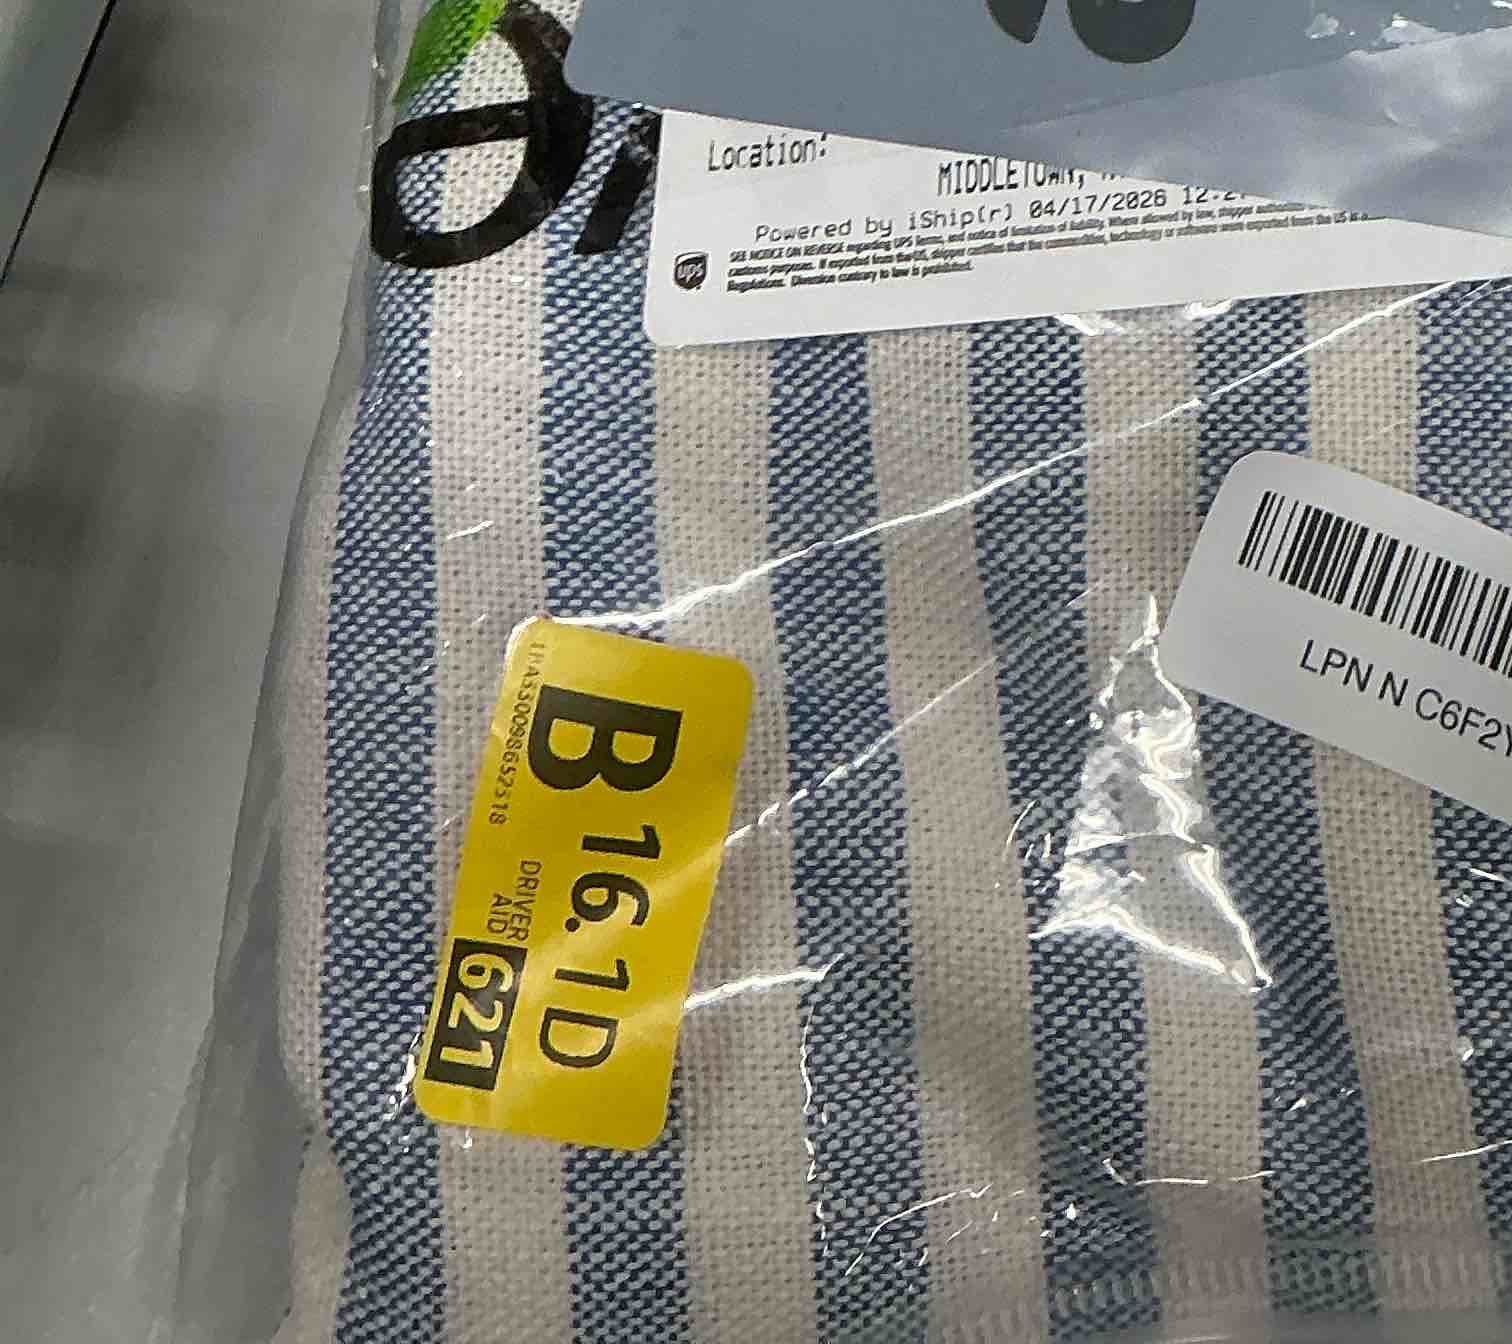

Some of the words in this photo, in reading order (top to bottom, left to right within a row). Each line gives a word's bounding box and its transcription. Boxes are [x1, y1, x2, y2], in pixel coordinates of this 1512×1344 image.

[708, 131, 827, 172] Location:
[755, 219, 852, 243] Powered
[865, 215, 892, 238] by
[1299, 639, 1375, 694] LPN
[1379, 679, 1409, 706] N
[527, 683, 685, 792] B
[486, 892, 513, 935] AID
[506, 859, 543, 943] DRIVER
[439, 952, 514, 1069] 621
